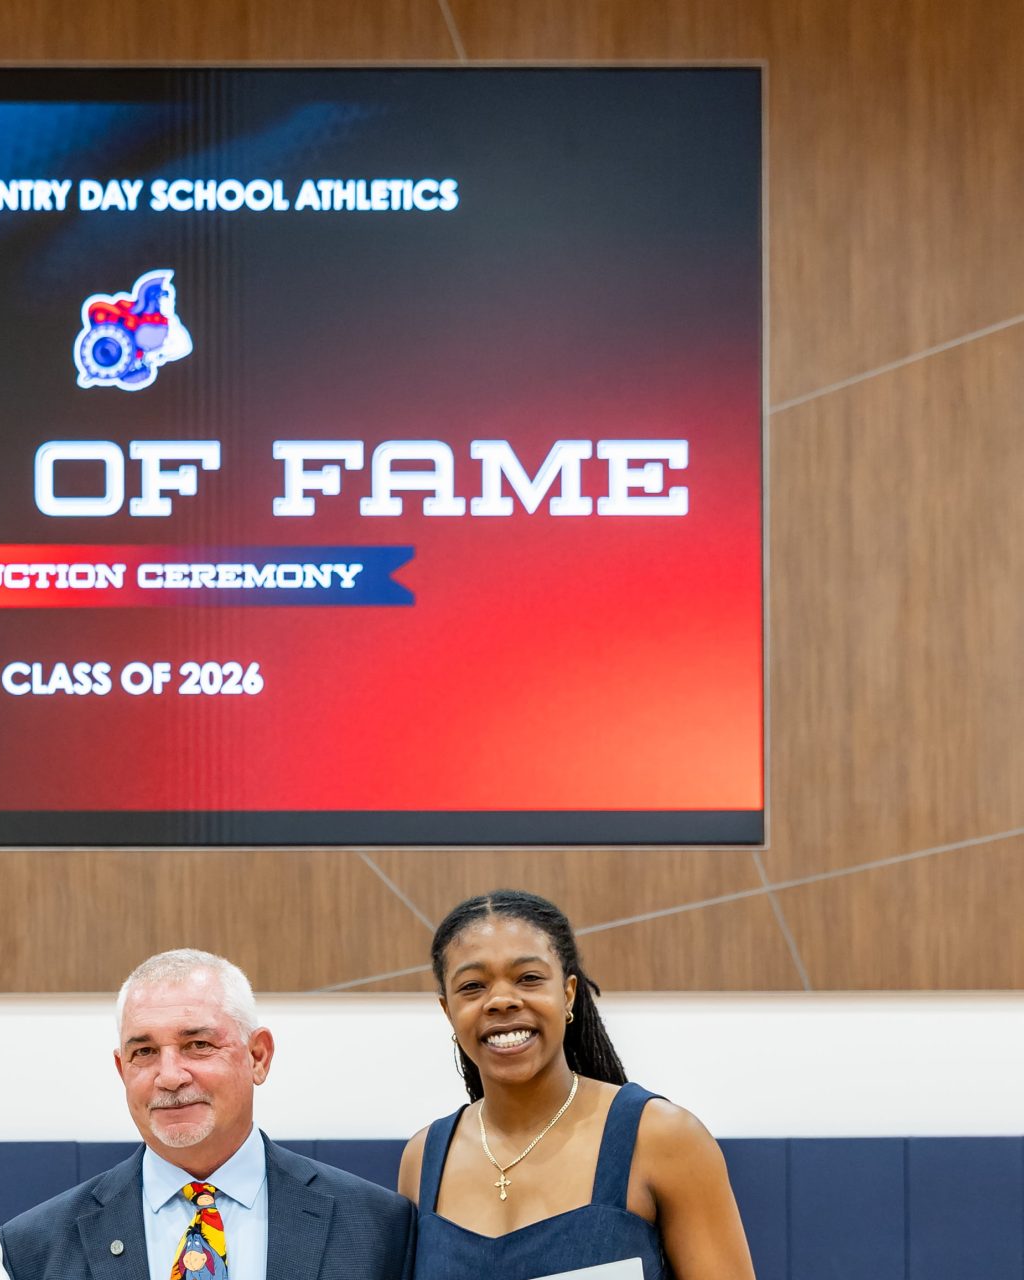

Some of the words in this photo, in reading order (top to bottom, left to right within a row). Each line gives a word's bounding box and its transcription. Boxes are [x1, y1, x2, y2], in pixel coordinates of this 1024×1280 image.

[80, 180, 142, 211] DAY
[151, 180, 289, 211] SCHOOL
[295, 180, 458, 211] ATHLETICS
[34, 439, 221, 518] OF
[272, 439, 689, 518] FAME
[137, 563, 363, 589] CEREMONY
[1, 661, 112, 696] CLASS
[120, 661, 171, 696] OF
[178, 661, 264, 696] 2026
